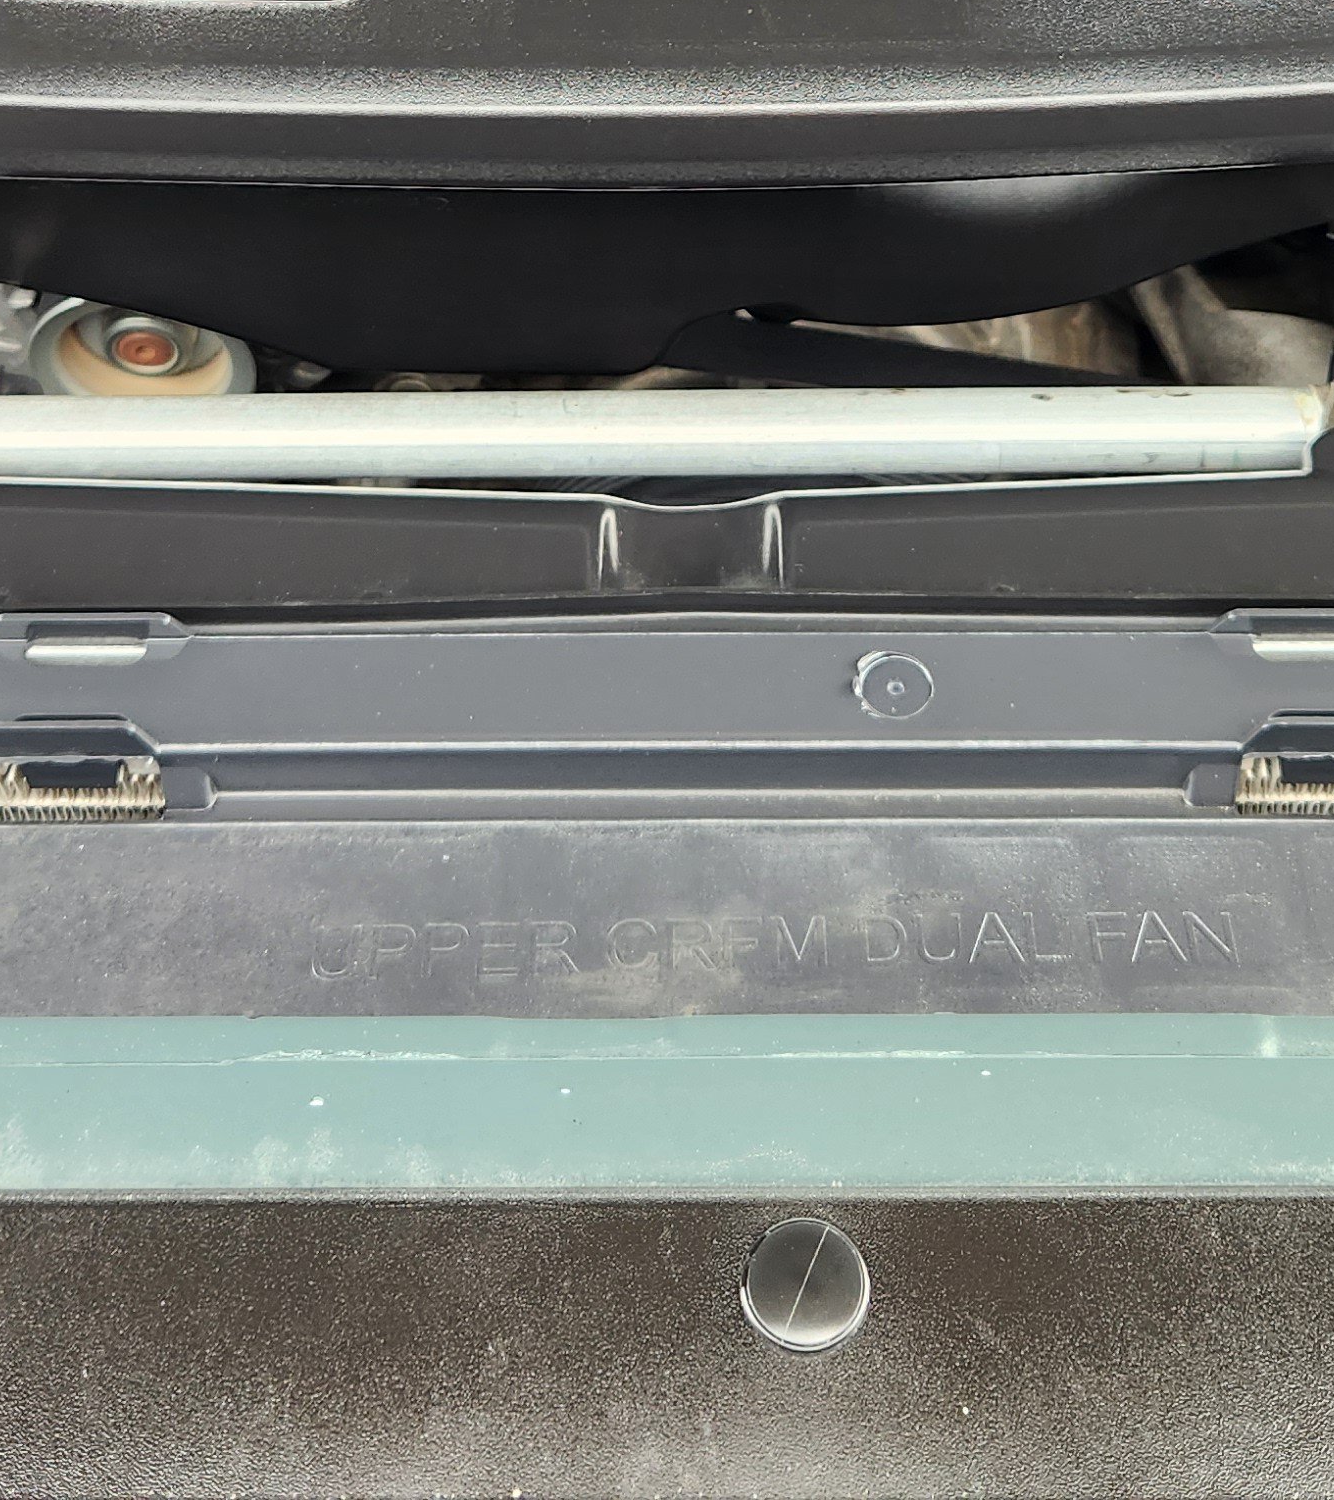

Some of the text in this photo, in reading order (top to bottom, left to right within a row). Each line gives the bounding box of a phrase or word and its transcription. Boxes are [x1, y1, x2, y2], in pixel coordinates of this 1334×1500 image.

[310, 909, 1241, 980] UPPER CRFM DUAL FAN
